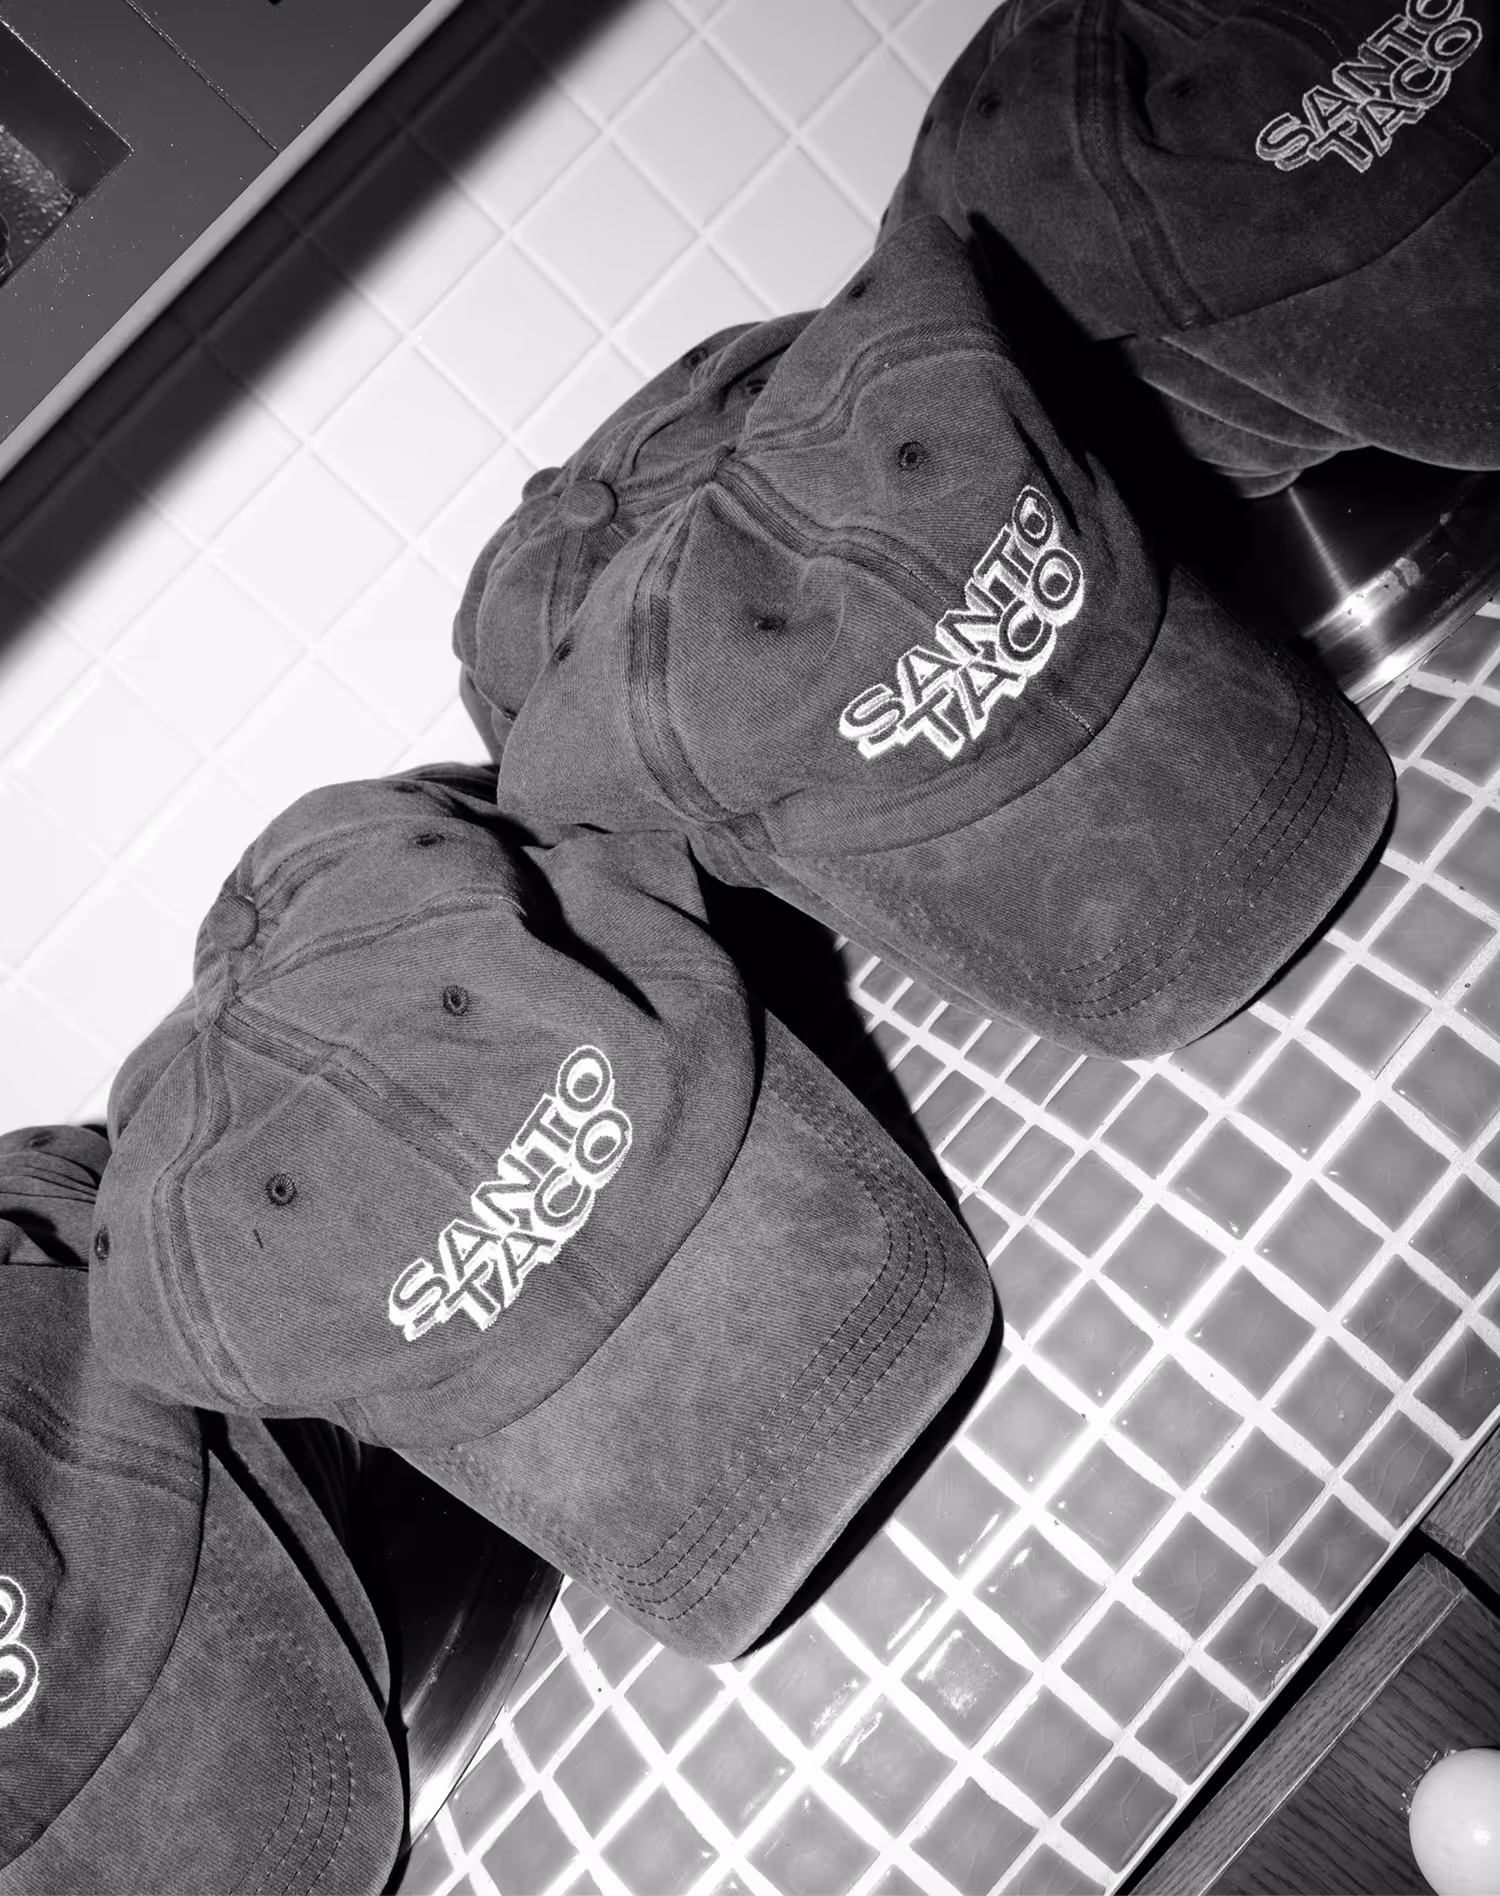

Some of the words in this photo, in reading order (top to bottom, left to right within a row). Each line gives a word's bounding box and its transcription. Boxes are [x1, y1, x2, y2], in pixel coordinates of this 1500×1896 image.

[1256, 0, 1465, 172] SANTO
[1307, 17, 1483, 173] TACO
[839, 485, 1060, 759] SANTO
[898, 546, 1085, 760] TACO
[388, 1045, 615, 1341] SANTO
[441, 1107, 633, 1331] TACO
